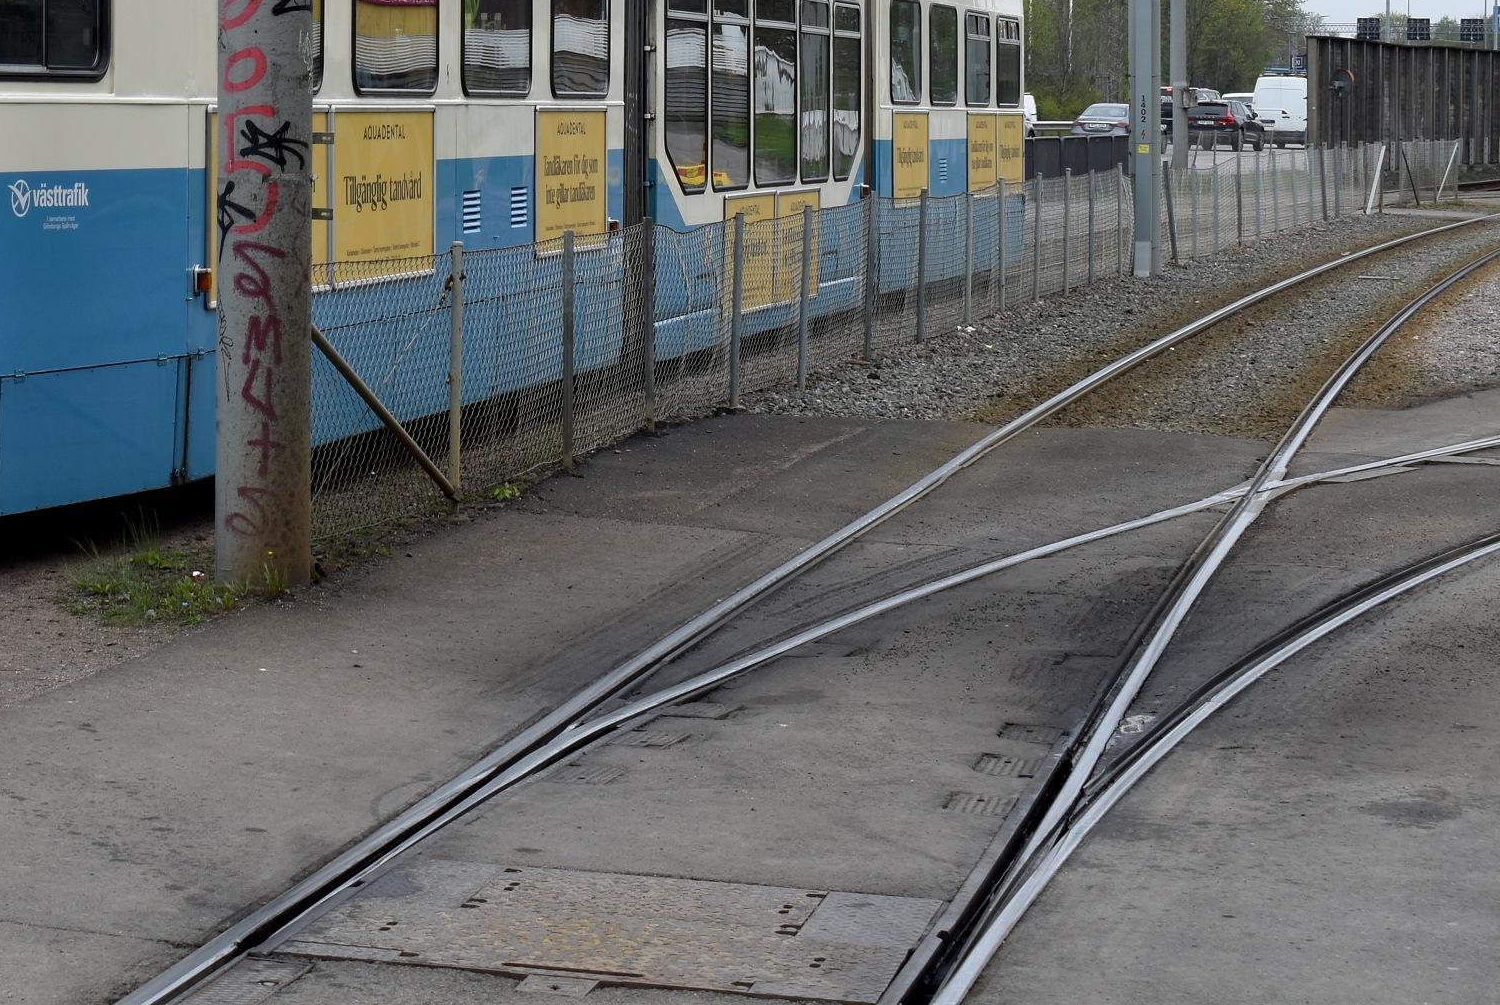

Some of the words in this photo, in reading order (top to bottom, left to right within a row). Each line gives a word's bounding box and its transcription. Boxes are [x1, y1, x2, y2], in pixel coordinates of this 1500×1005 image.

[363, 124, 406, 140] AQUADENTAL
[32, 182, 90, 207] västtrafik
[343, 173, 388, 212] Tillgänglig
[389, 170, 422, 202] tandvård
